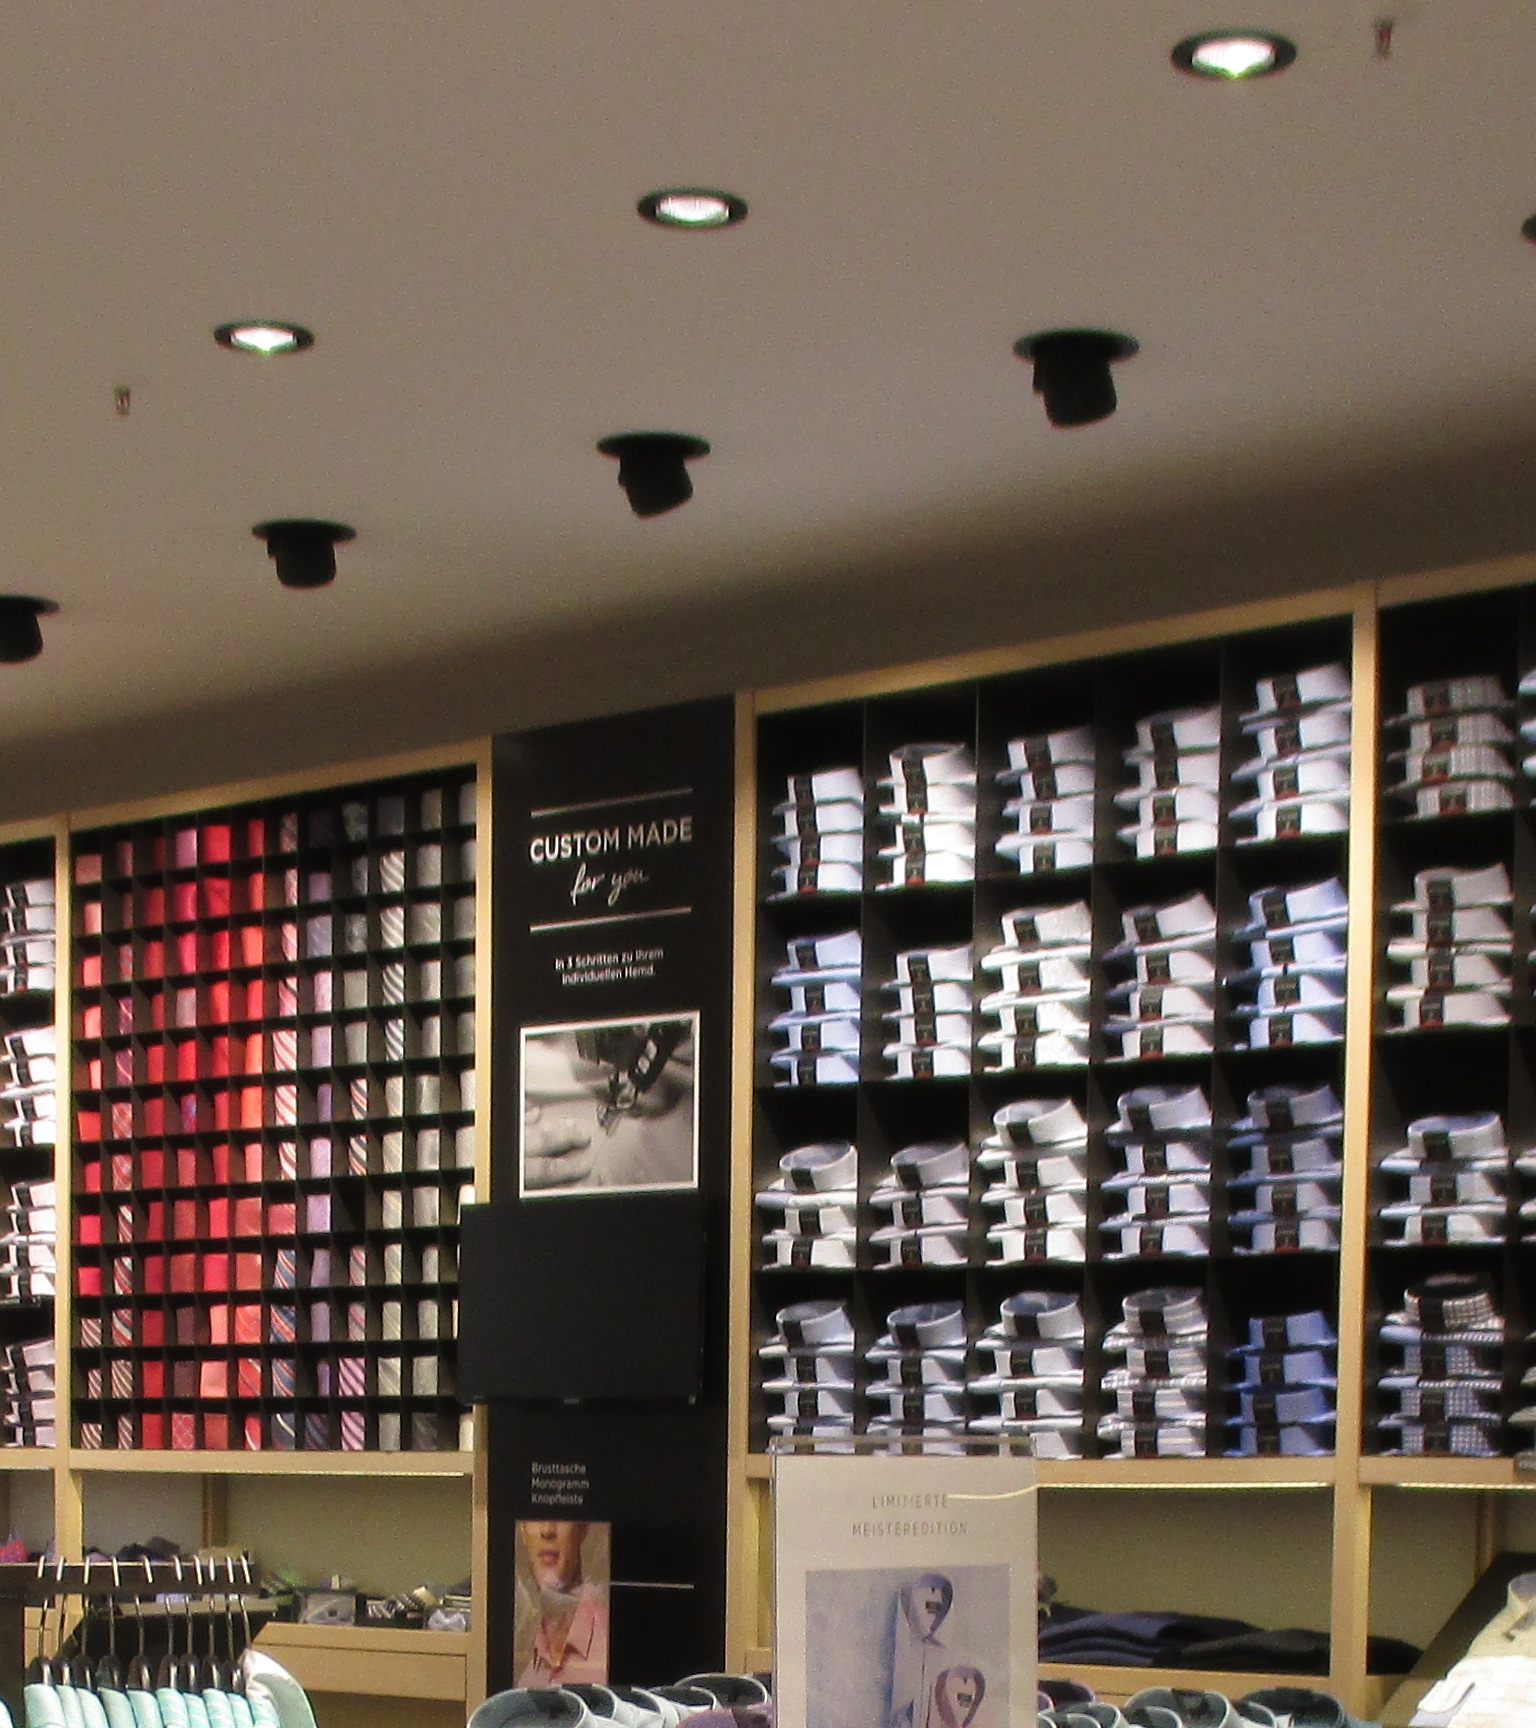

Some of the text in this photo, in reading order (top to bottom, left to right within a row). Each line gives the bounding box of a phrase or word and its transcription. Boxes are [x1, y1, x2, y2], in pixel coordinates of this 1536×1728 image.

[530, 815, 693, 863] CUSTOM MADE
[570, 861, 649, 906] for you
[555, 957, 565, 970] In
[576, 952, 619, 968] Schritten
[531, 1477, 590, 1490] Monogramm
[872, 1494, 947, 1510] LIMITIERTE
[851, 1521, 968, 1537] MEISTEREDITION
